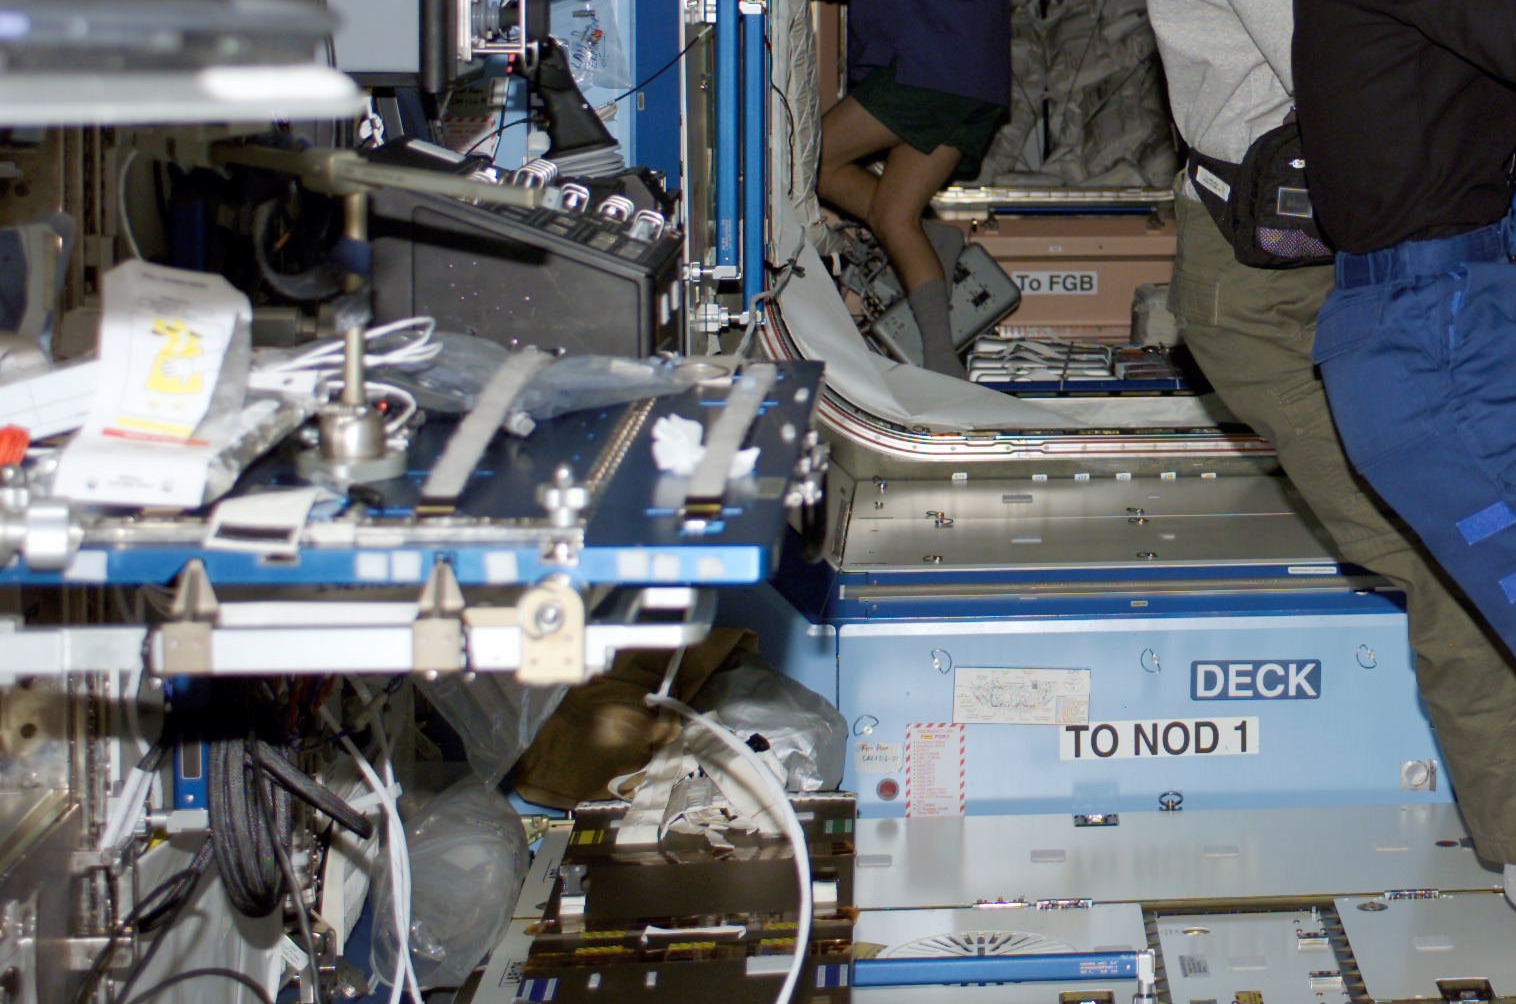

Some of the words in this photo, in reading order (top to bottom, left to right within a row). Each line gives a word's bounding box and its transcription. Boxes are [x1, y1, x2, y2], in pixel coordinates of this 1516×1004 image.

[1016, 275, 1042, 291] To
[1049, 274, 1093, 291] FGB
[1196, 663, 1318, 697] DECK
[1065, 724, 1119, 757] TO
[1134, 721, 1219, 755] NOD
[1234, 720, 1247, 752] 1
